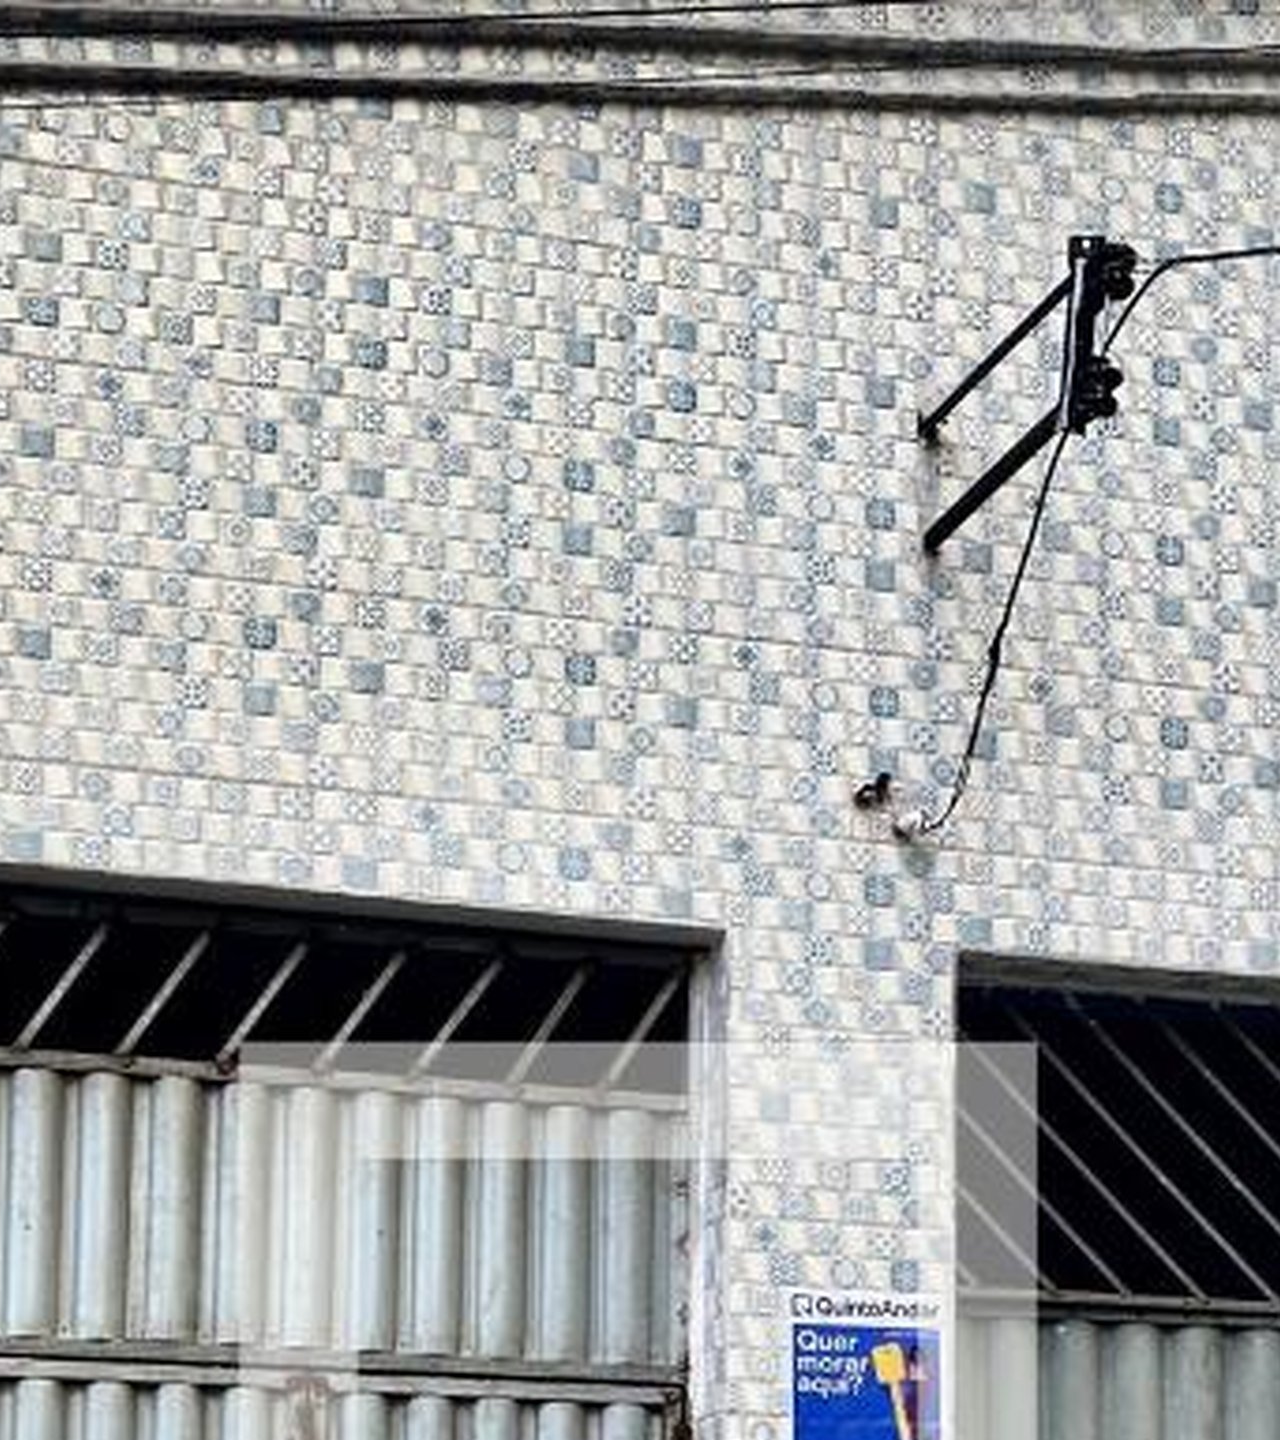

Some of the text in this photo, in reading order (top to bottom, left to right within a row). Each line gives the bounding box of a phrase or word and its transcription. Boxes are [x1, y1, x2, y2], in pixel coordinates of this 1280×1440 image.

[815, 1297, 941, 1318] QuintoAndar
[796, 1330, 860, 1352] Quer
[796, 1356, 869, 1373] morar
[796, 1375, 864, 1399] aqui?
